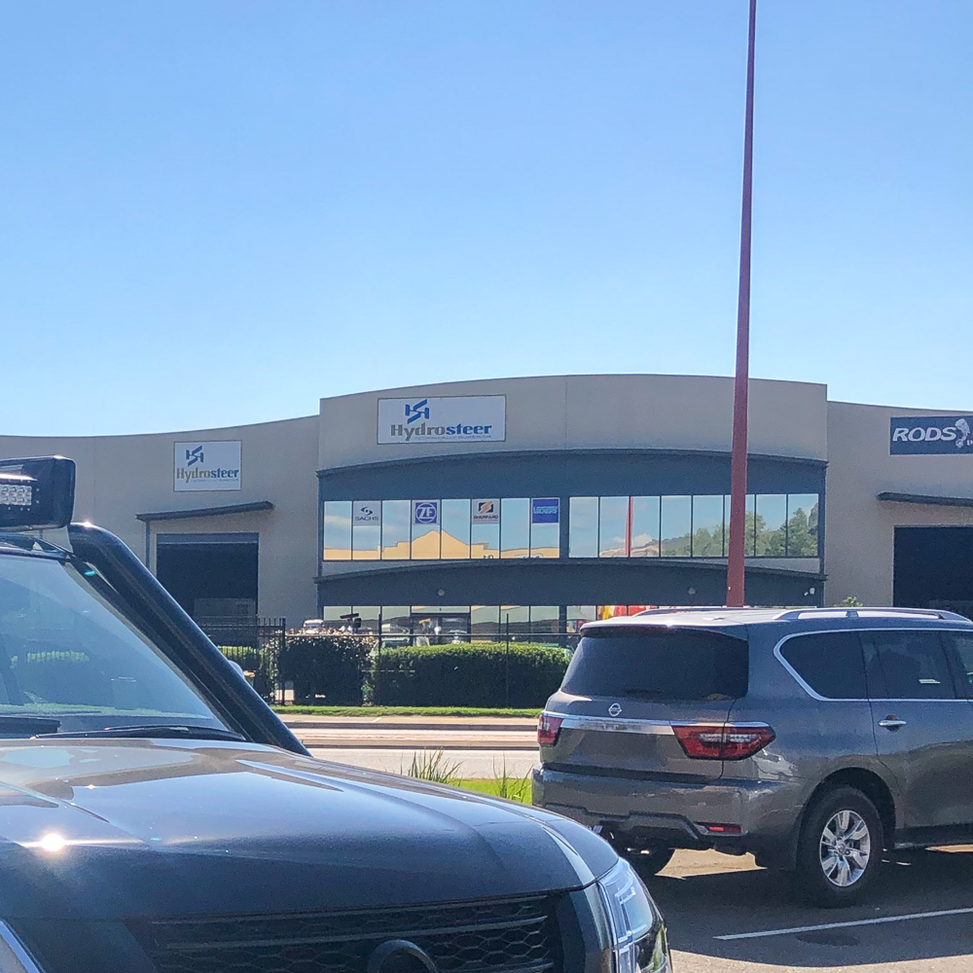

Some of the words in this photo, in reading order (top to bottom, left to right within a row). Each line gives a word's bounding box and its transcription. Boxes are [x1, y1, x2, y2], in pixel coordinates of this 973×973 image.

[390, 422, 492, 441] Hydrosteer
[892, 427, 957, 441] RODS
[177, 467, 239, 483] Hydrosteer
